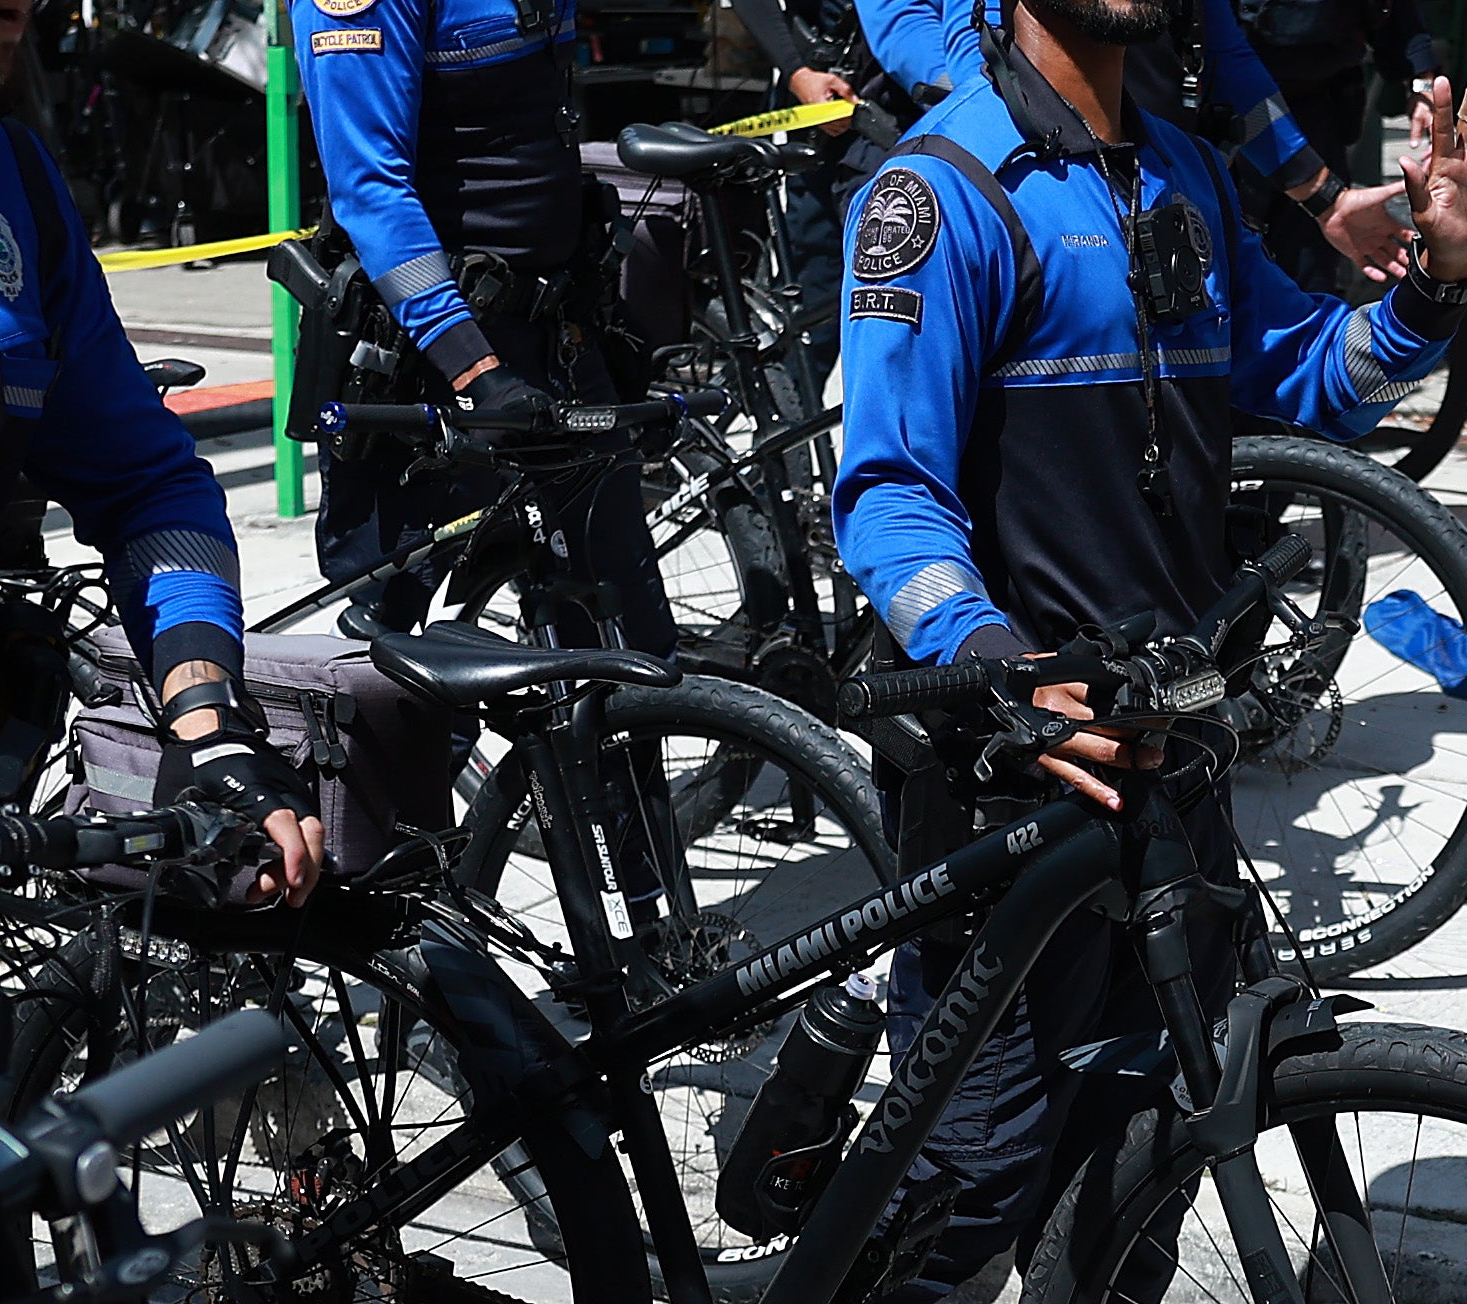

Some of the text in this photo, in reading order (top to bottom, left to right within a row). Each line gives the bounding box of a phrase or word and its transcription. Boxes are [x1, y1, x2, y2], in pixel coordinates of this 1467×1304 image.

[313, 34, 343, 48] BICYCLE
[889, 174, 904, 187] OF
[905, 180, 932, 225] MIAMI
[857, 253, 903, 271] POLICE
[853, 292, 895, 310] B.R.T.
[1006, 821, 1044, 857] 422
[595, 843, 618, 893] SUNTOUR
[736, 861, 957, 996] MIAMI POLICE
